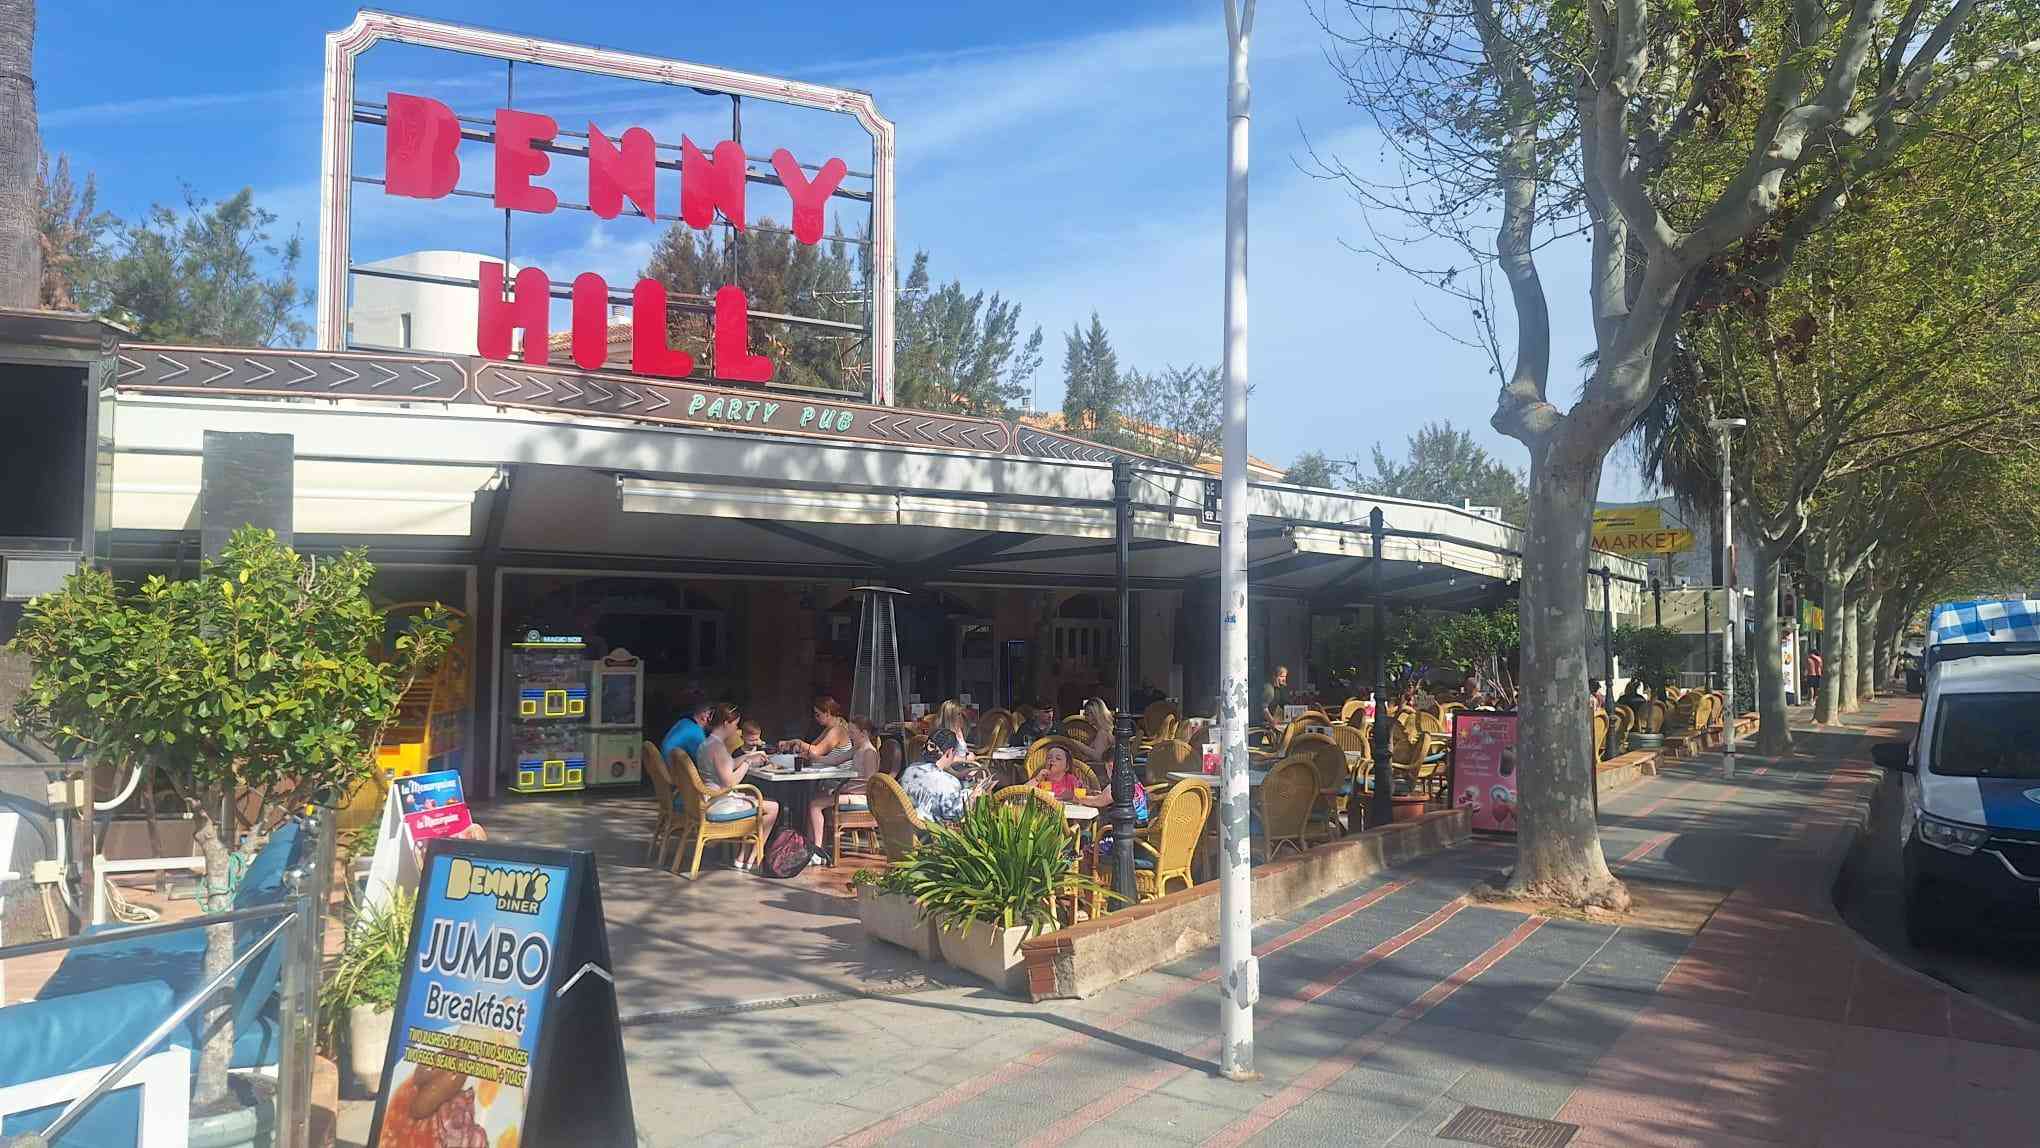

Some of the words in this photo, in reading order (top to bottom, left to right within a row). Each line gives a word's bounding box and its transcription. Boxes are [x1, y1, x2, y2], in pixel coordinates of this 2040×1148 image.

[386, 92, 847, 246] BENNY
[478, 261, 774, 382] HILL
[688, 393, 780, 424] PARTY
[799, 406, 854, 432] PUB
[1591, 532, 1680, 550] MARKET
[446, 858, 550, 901] BENNY'S
[496, 899, 540, 914] DINER
[421, 921, 549, 987] JUMBO
[426, 984, 526, 1032] Breakfast
[482, 1043, 497, 1058] TWO
[505, 1070, 526, 1087] TOAST
